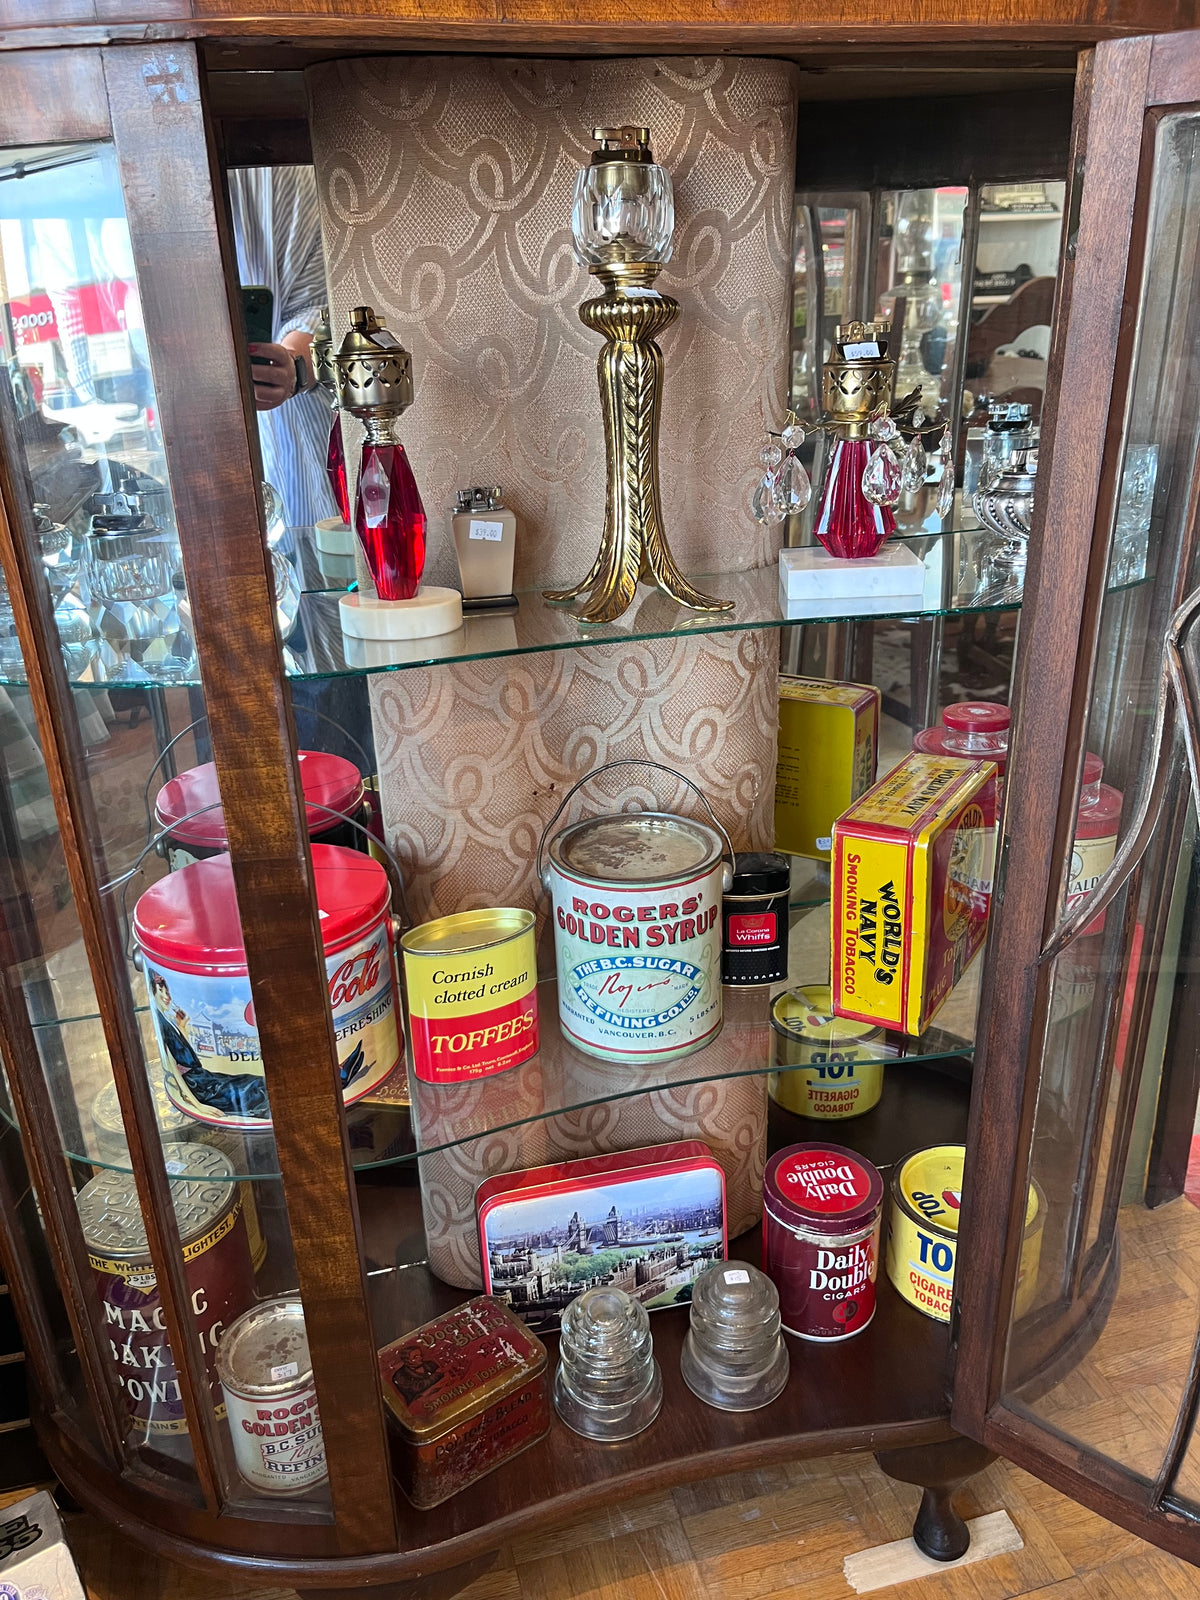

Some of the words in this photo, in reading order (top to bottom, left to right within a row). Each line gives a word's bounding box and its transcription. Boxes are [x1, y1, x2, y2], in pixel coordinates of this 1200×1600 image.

[920, 768, 960, 796] WORLD'S
[901, 793, 933, 817] NAVY
[846, 853, 861, 921] SMOKING
[572, 893, 703, 923] ROGERS'
[556, 905, 640, 949] GOLDEN
[646, 904, 718, 948] SYRUP
[736, 932, 771, 941] Whiffs
[858, 898, 878, 967] NAVY
[874, 880, 902, 986] WORLD'S
[432, 963, 494, 985] Cornish
[575, 961, 600, 978] THE
[601, 957, 631, 970] B.C.
[632, 956, 695, 977] SUGAR
[845, 927, 859, 995] TOBACCO
[434, 984, 486, 1005] clotted
[489, 971, 529, 995] cream
[334, 996, 393, 1042] EFRESHING
[577, 990, 658, 1029] REFINING
[431, 1008, 534, 1054] TOFFEES
[229, 1051, 260, 1062] DEL
[786, 1165, 856, 1188] Double
[794, 1160, 836, 1171] CIGARS
[805, 1181, 859, 1202] Daily
[911, 1191, 946, 1219] TOP
[89, 1256, 110, 1271] THE
[816, 1244, 872, 1271] Daily
[916, 1230, 954, 1273] TO
[808, 1261, 876, 1291] Double
[909, 1270, 954, 1302] CIGARE
[822, 1283, 867, 1302] CIGARS
[256, 1394, 318, 1421] ROGE
[241, 1412, 313, 1437] GOLDEN
[266, 1453, 324, 1473] REFIN
